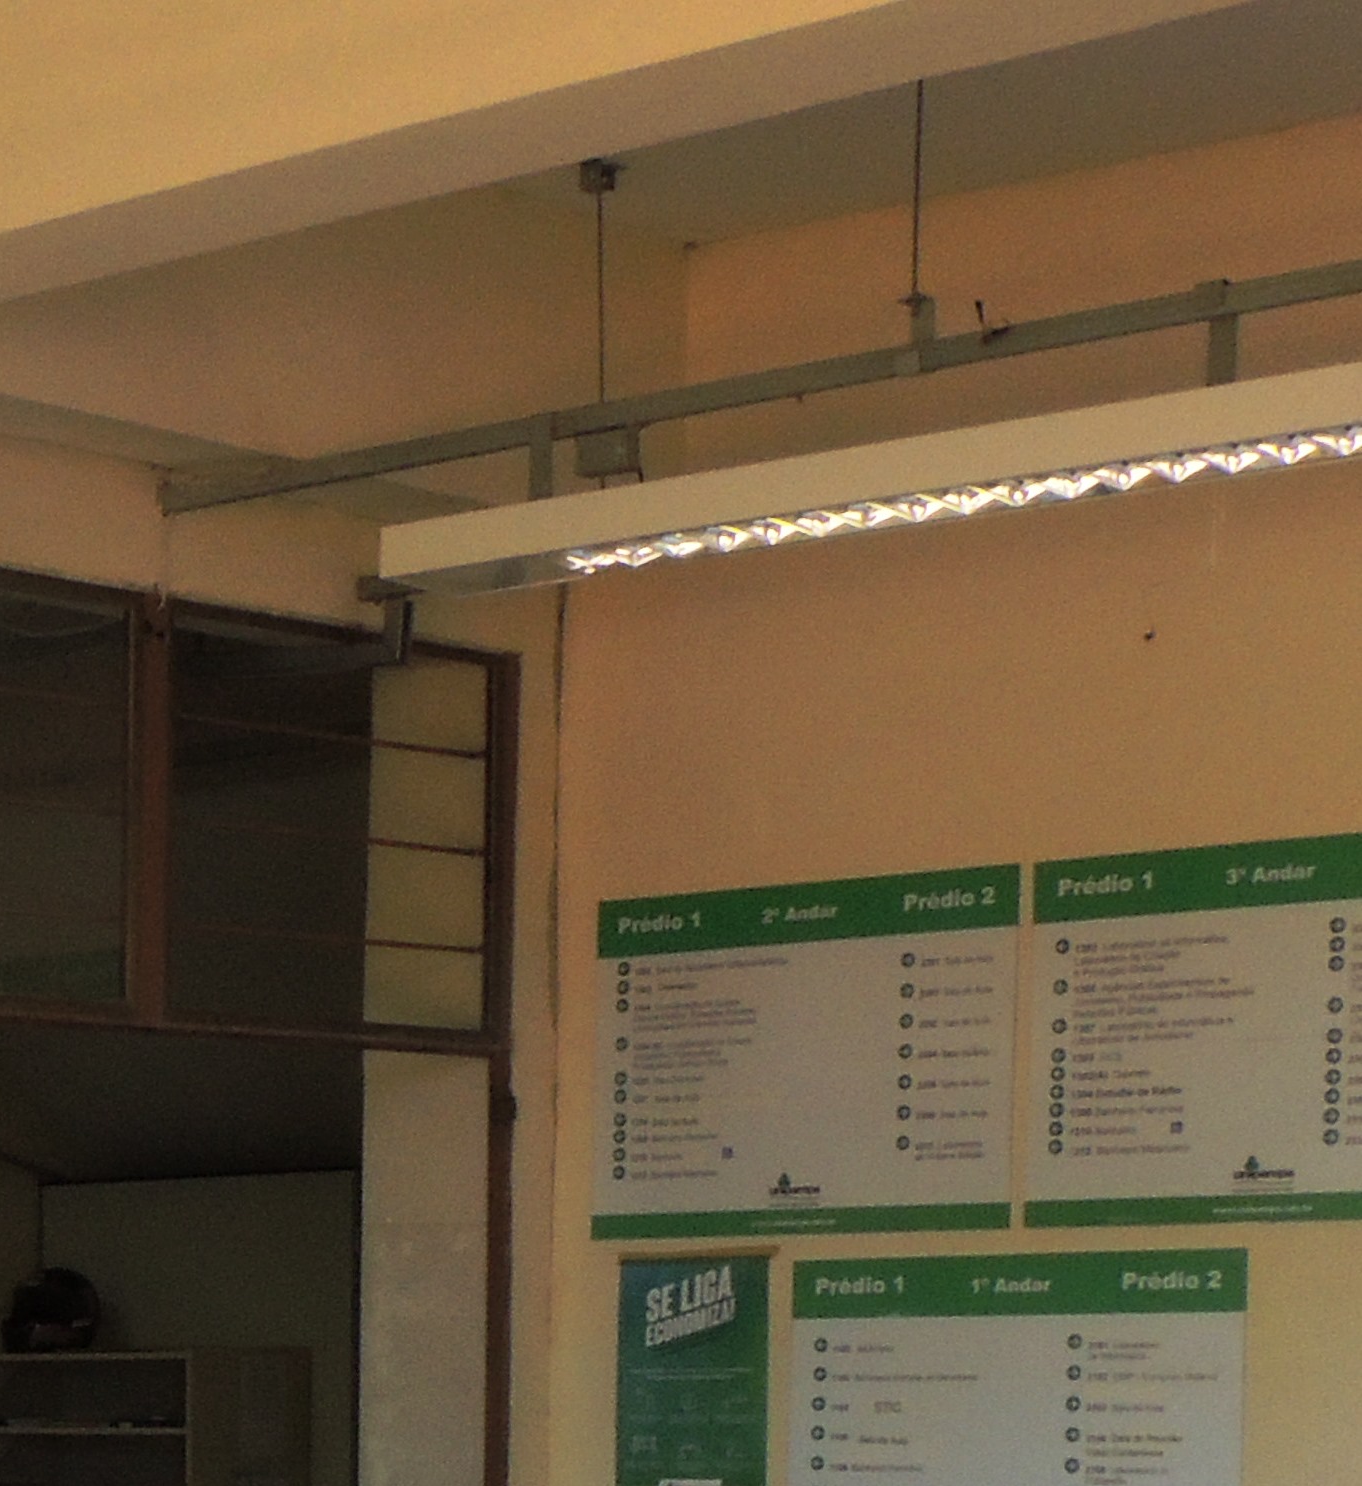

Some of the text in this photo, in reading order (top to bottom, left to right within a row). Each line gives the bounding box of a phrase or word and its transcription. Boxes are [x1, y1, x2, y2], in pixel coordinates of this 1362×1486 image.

[1058, 873, 1134, 897] Prédio
[1142, 870, 1154, 889] 1
[1251, 862, 1317, 884] Andar
[617, 914, 683, 935] Prédio
[692, 911, 701, 929] 1
[784, 903, 838, 922] Andar
[903, 890, 977, 912] Prédio
[981, 886, 996, 905] 2
[646, 1265, 734, 1323] SE LIGA
[815, 1274, 887, 1296] Prédio
[893, 1274, 904, 1293] 1
[994, 1276, 1052, 1294] Andar
[1121, 1270, 1199, 1291] Prédio
[1206, 1270, 1223, 1289] 2
